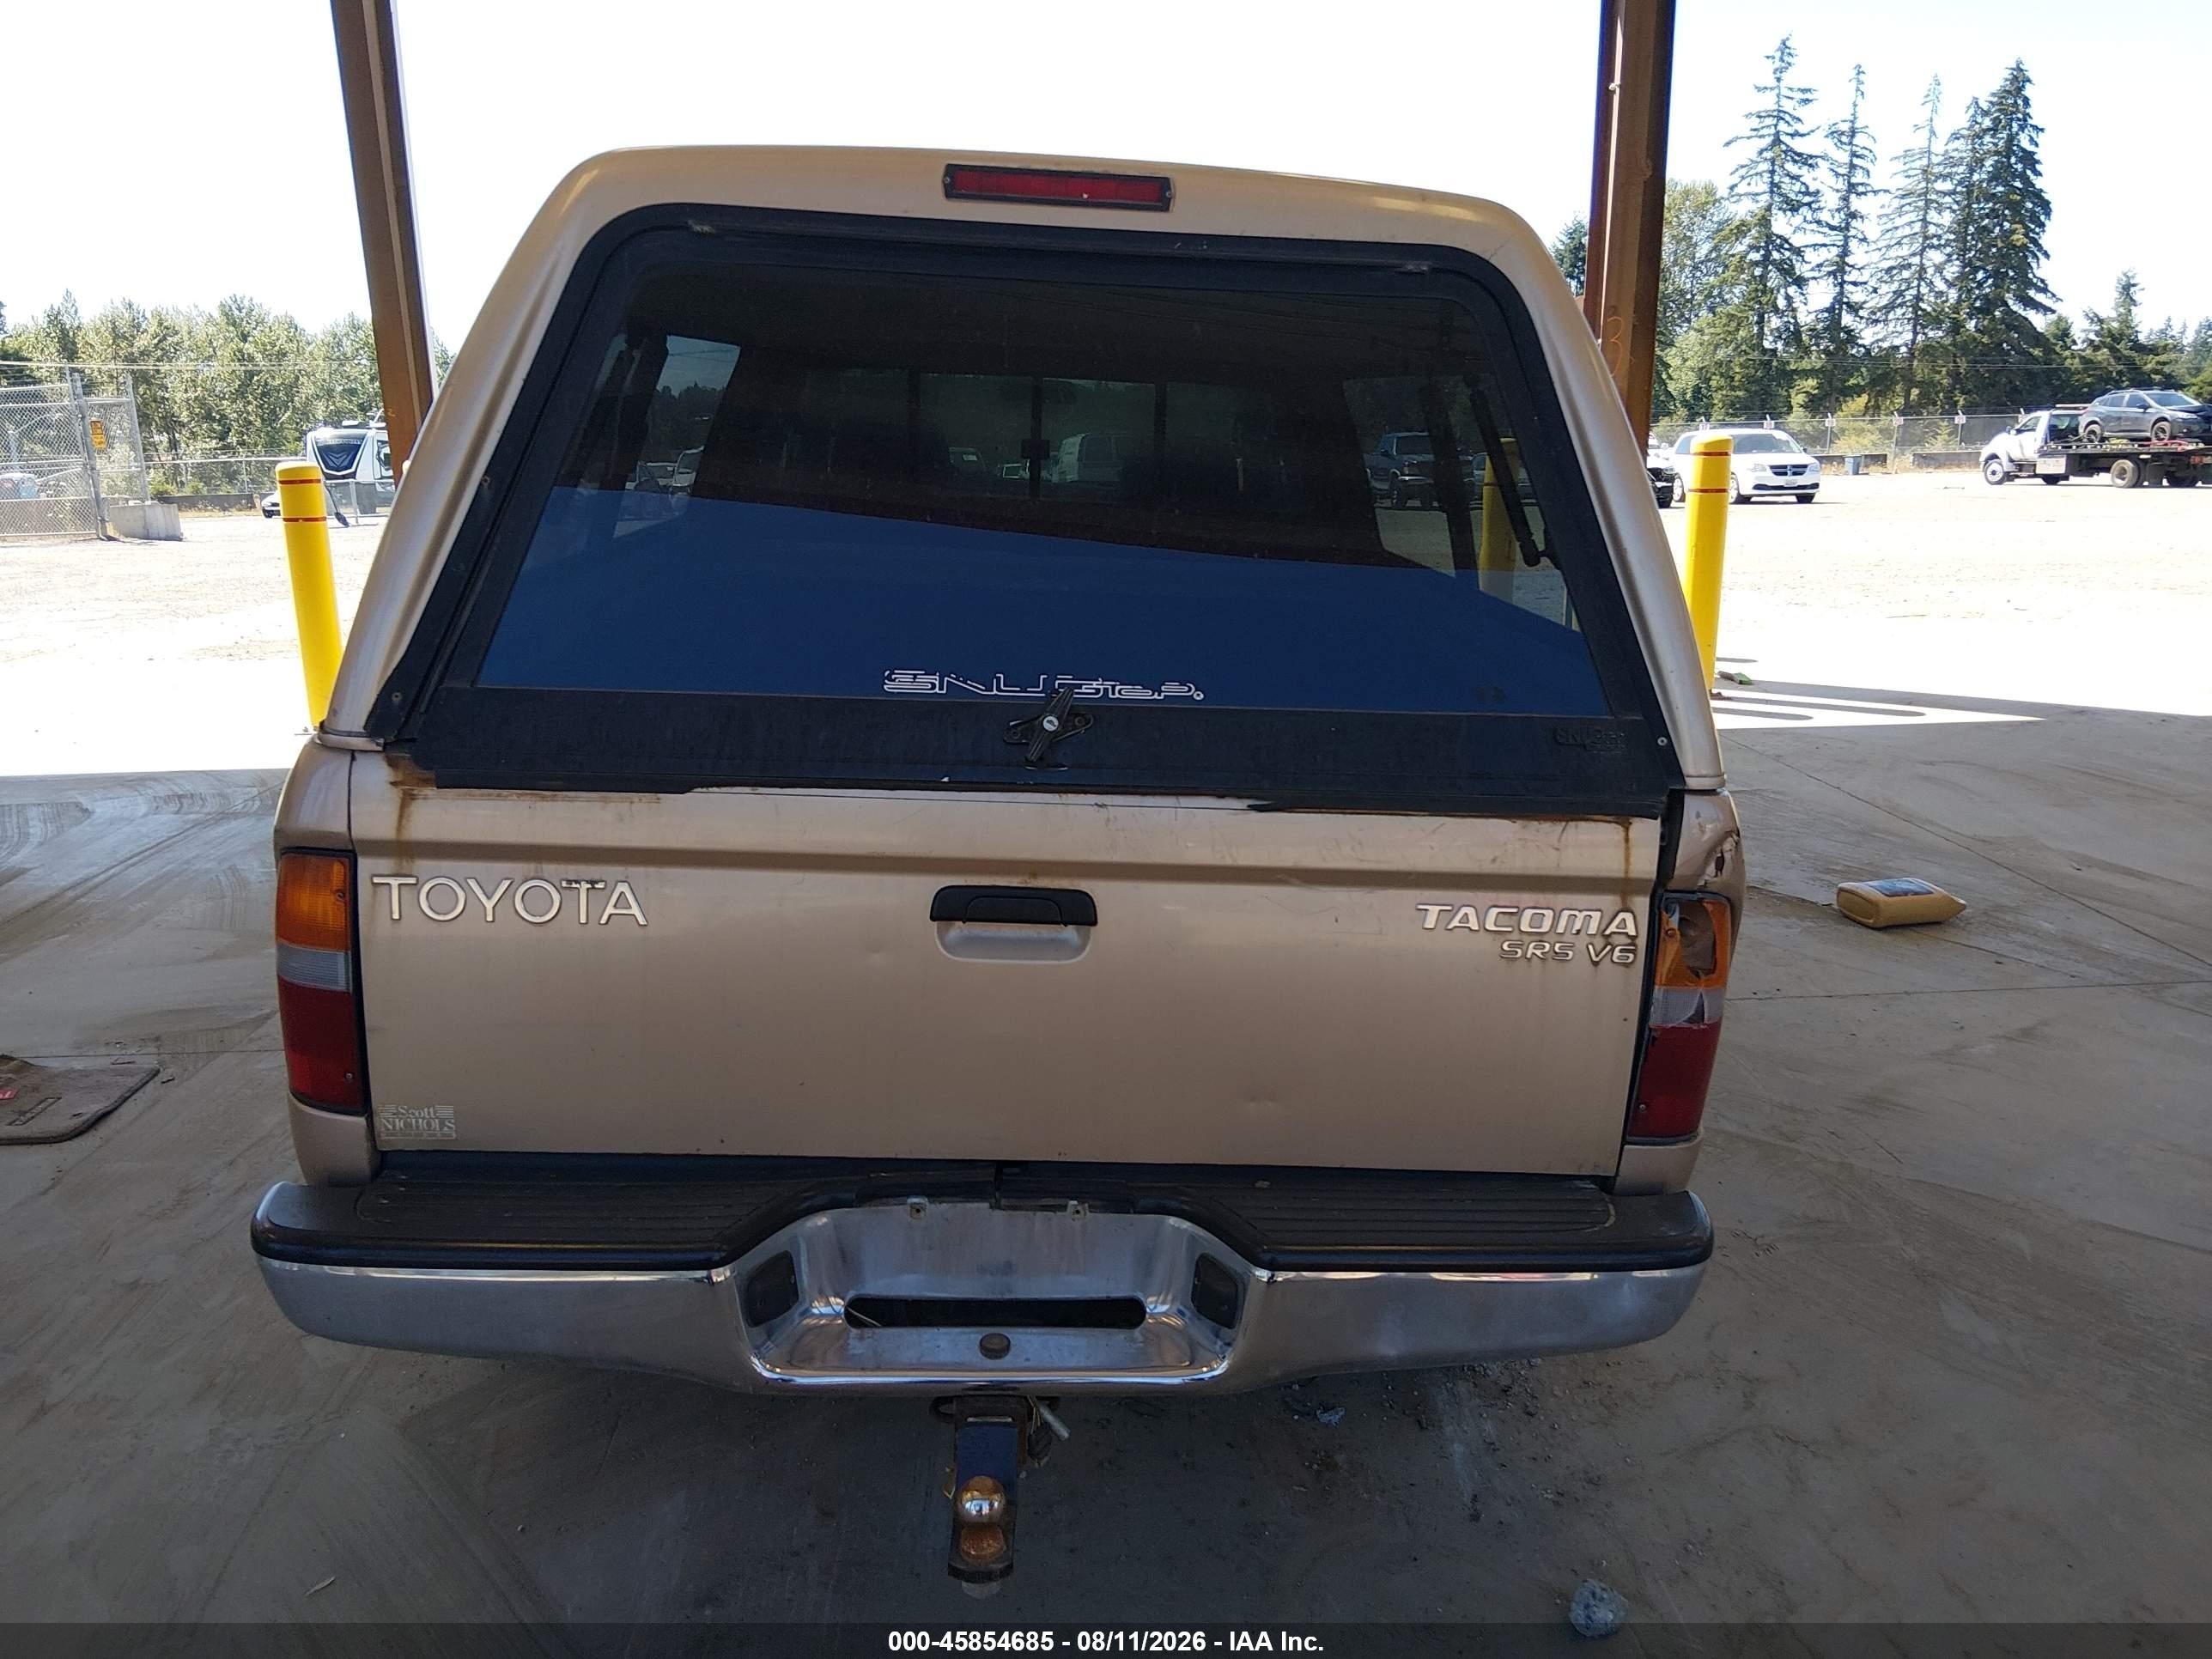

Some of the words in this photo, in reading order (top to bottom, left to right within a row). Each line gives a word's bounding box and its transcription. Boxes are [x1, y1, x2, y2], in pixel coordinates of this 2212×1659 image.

[372, 876, 648, 926] TOYOTA
[1416, 903, 1638, 936] TACOMA
[1499, 940, 1574, 961] SR5
[1586, 943, 1637, 964] V6
[398, 1105, 437, 1119] Scott
[381, 1118, 455, 1131] NICHOLS
